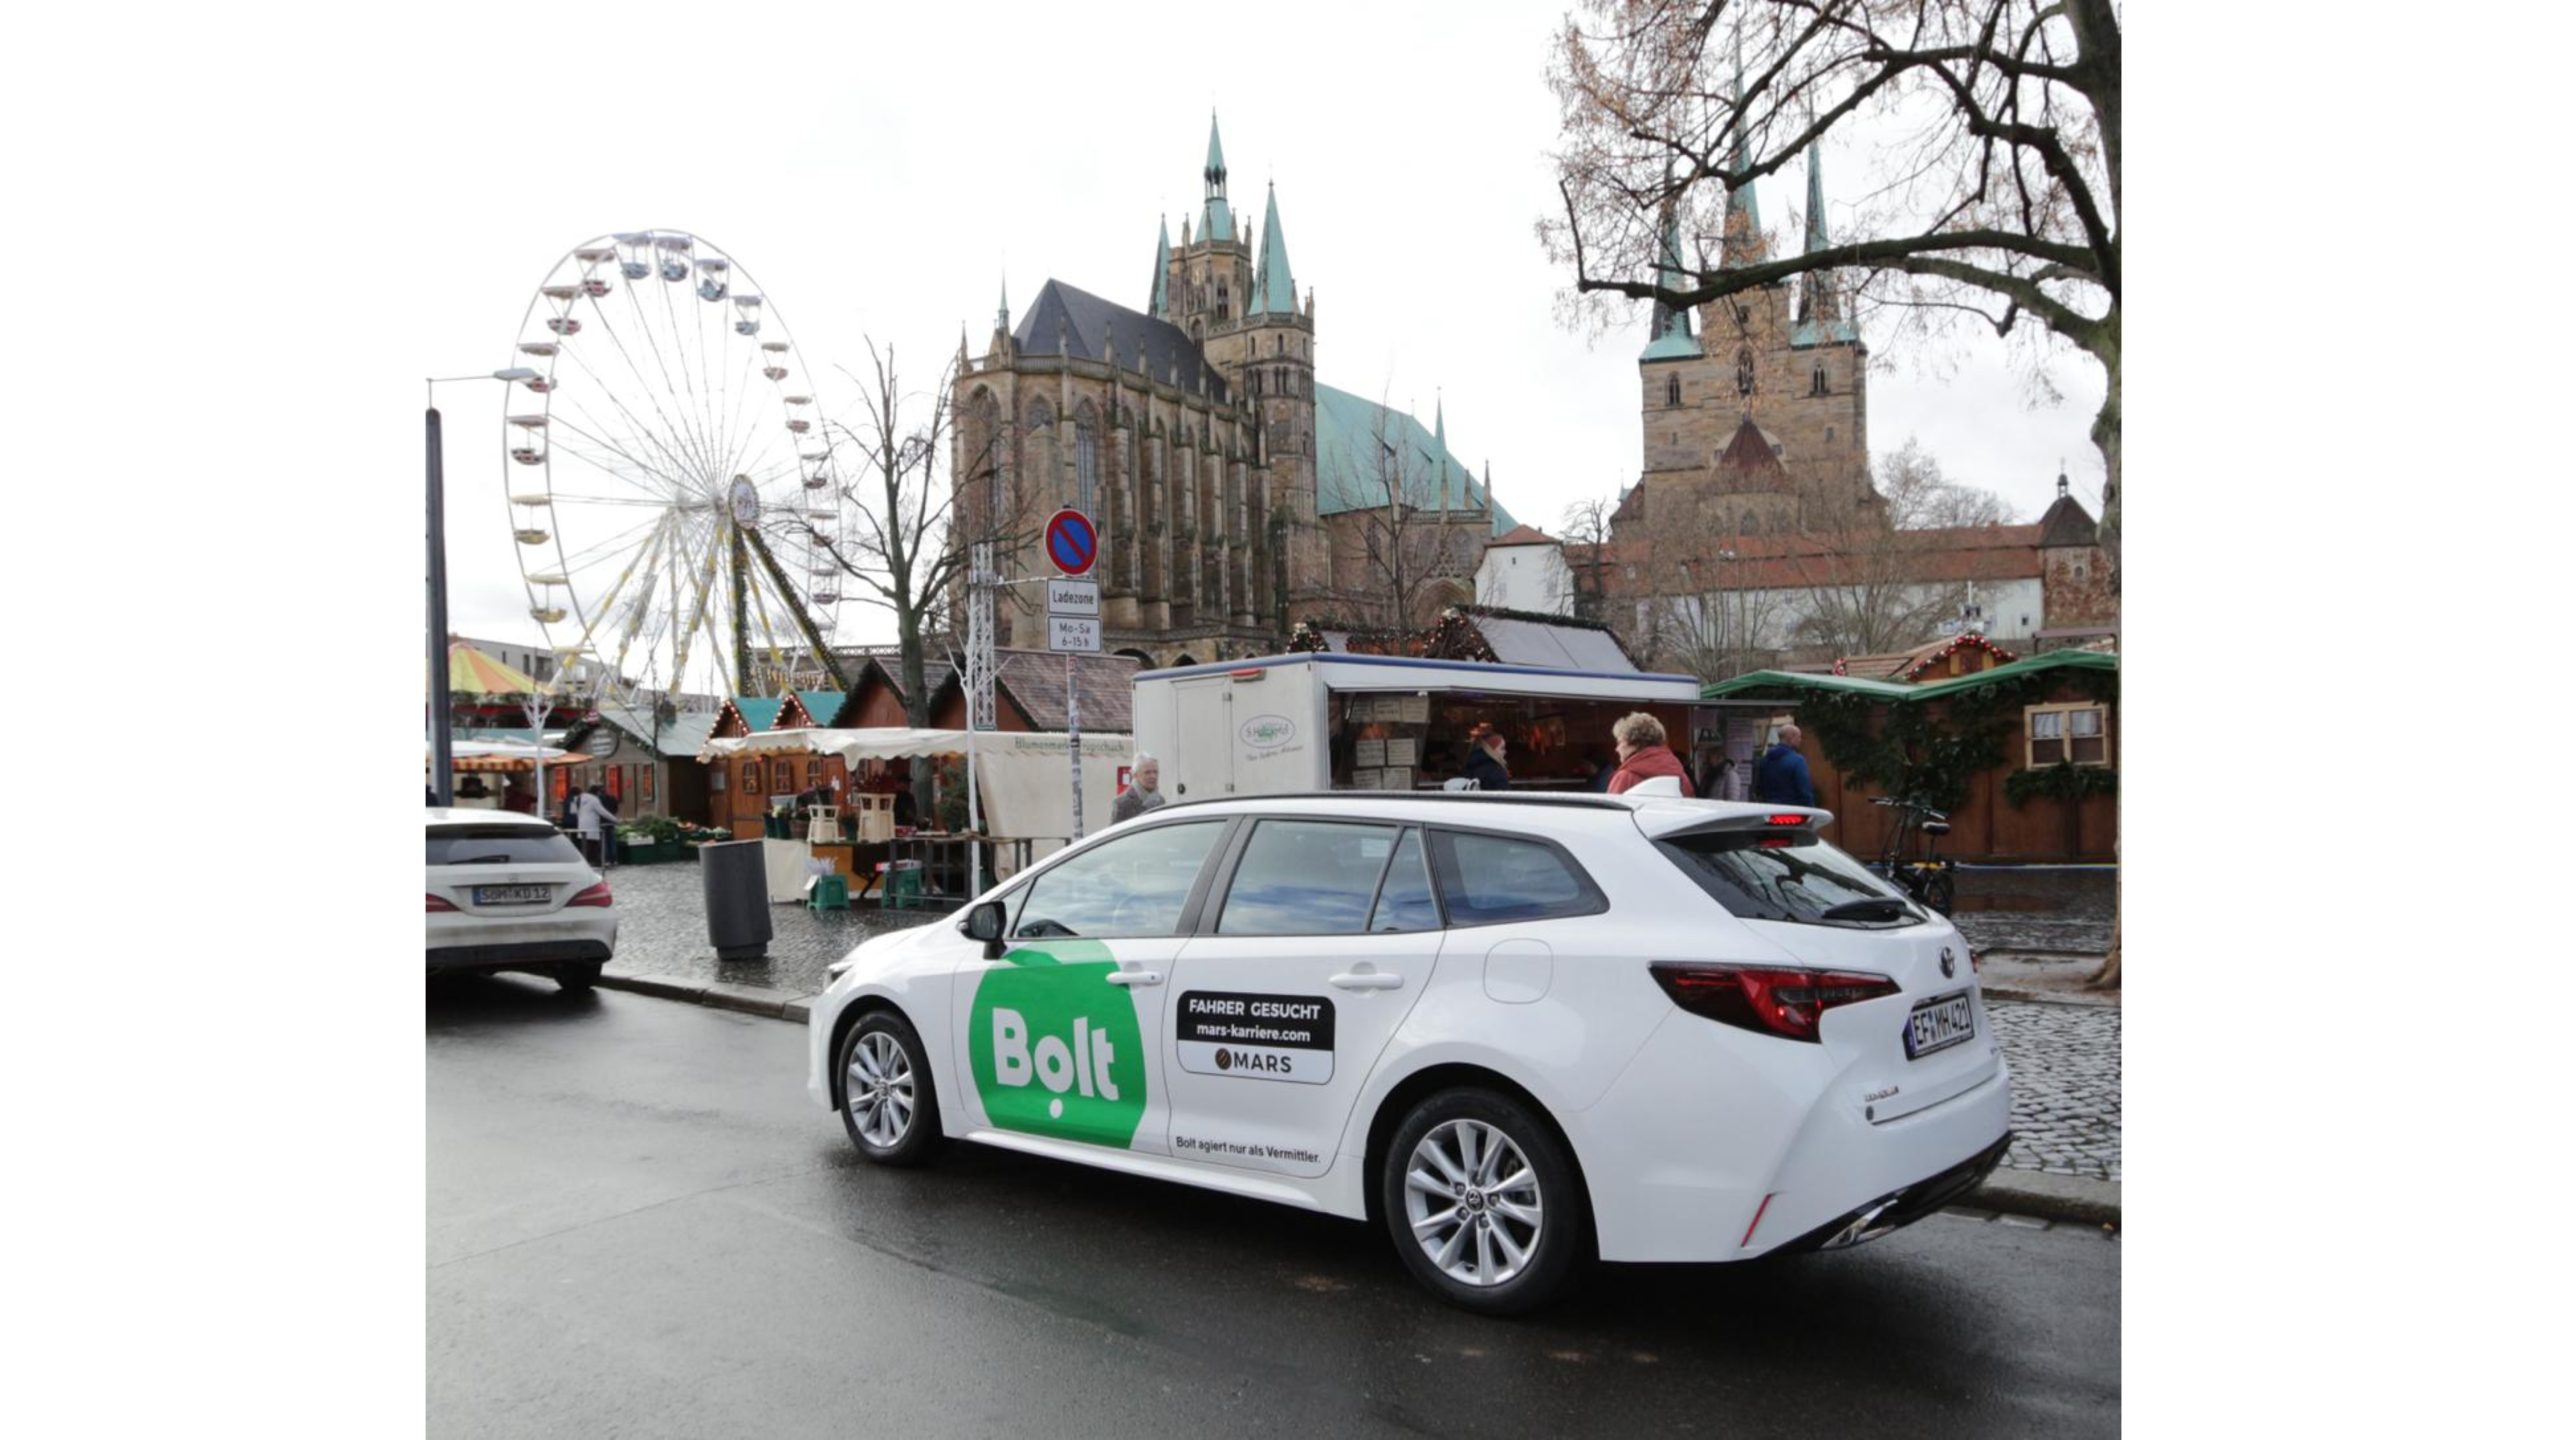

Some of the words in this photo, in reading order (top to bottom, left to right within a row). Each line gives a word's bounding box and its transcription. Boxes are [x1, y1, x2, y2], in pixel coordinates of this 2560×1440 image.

[1053, 590, 1094, 605] Ladezone
[1059, 623, 1091, 635] Mo-Sa
[534, 886, 549, 899] 12
[1189, 999, 1246, 1016] FAHRER
[1250, 1002, 1322, 1020] GESUCHT
[1196, 1024, 1311, 1042] mars-karriere.com
[1913, 1012, 1929, 1045] EF
[1935, 1006, 1952, 1039] MH
[1951, 1000, 1970, 1032] 421
[993, 1007, 1119, 1118] Bolt
[1233, 1051, 1292, 1074] MARS
[1176, 1136, 1196, 1149] Bolt
[1198, 1141, 1227, 1153] agiert
[1229, 1144, 1246, 1154] nur
[1250, 1145, 1264, 1157] als
[1266, 1146, 1321, 1163] Vermittler.
